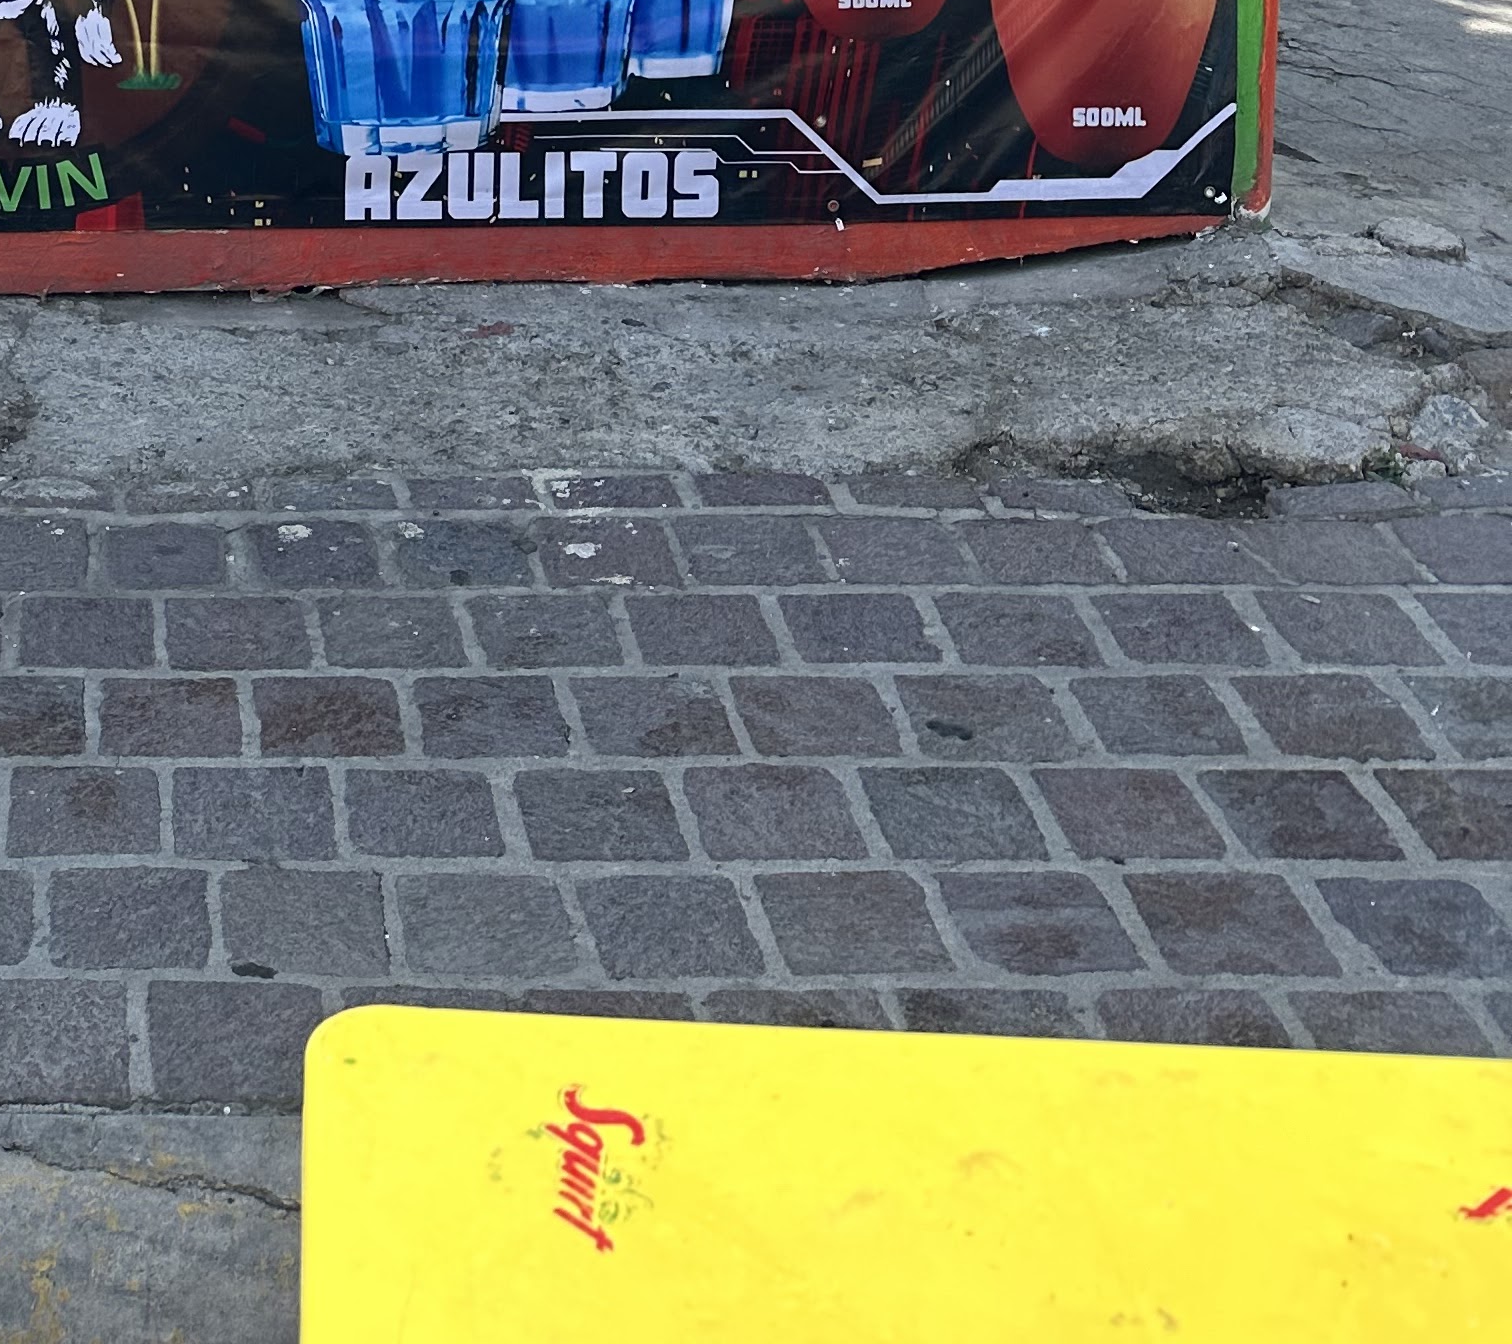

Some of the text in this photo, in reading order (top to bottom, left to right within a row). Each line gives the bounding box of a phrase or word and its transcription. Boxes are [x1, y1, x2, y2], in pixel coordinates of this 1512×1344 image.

[1072, 107, 1147, 128] 500ML
[344, 150, 720, 221] AZULITOS
[544, 1089, 646, 1253] Squirt
